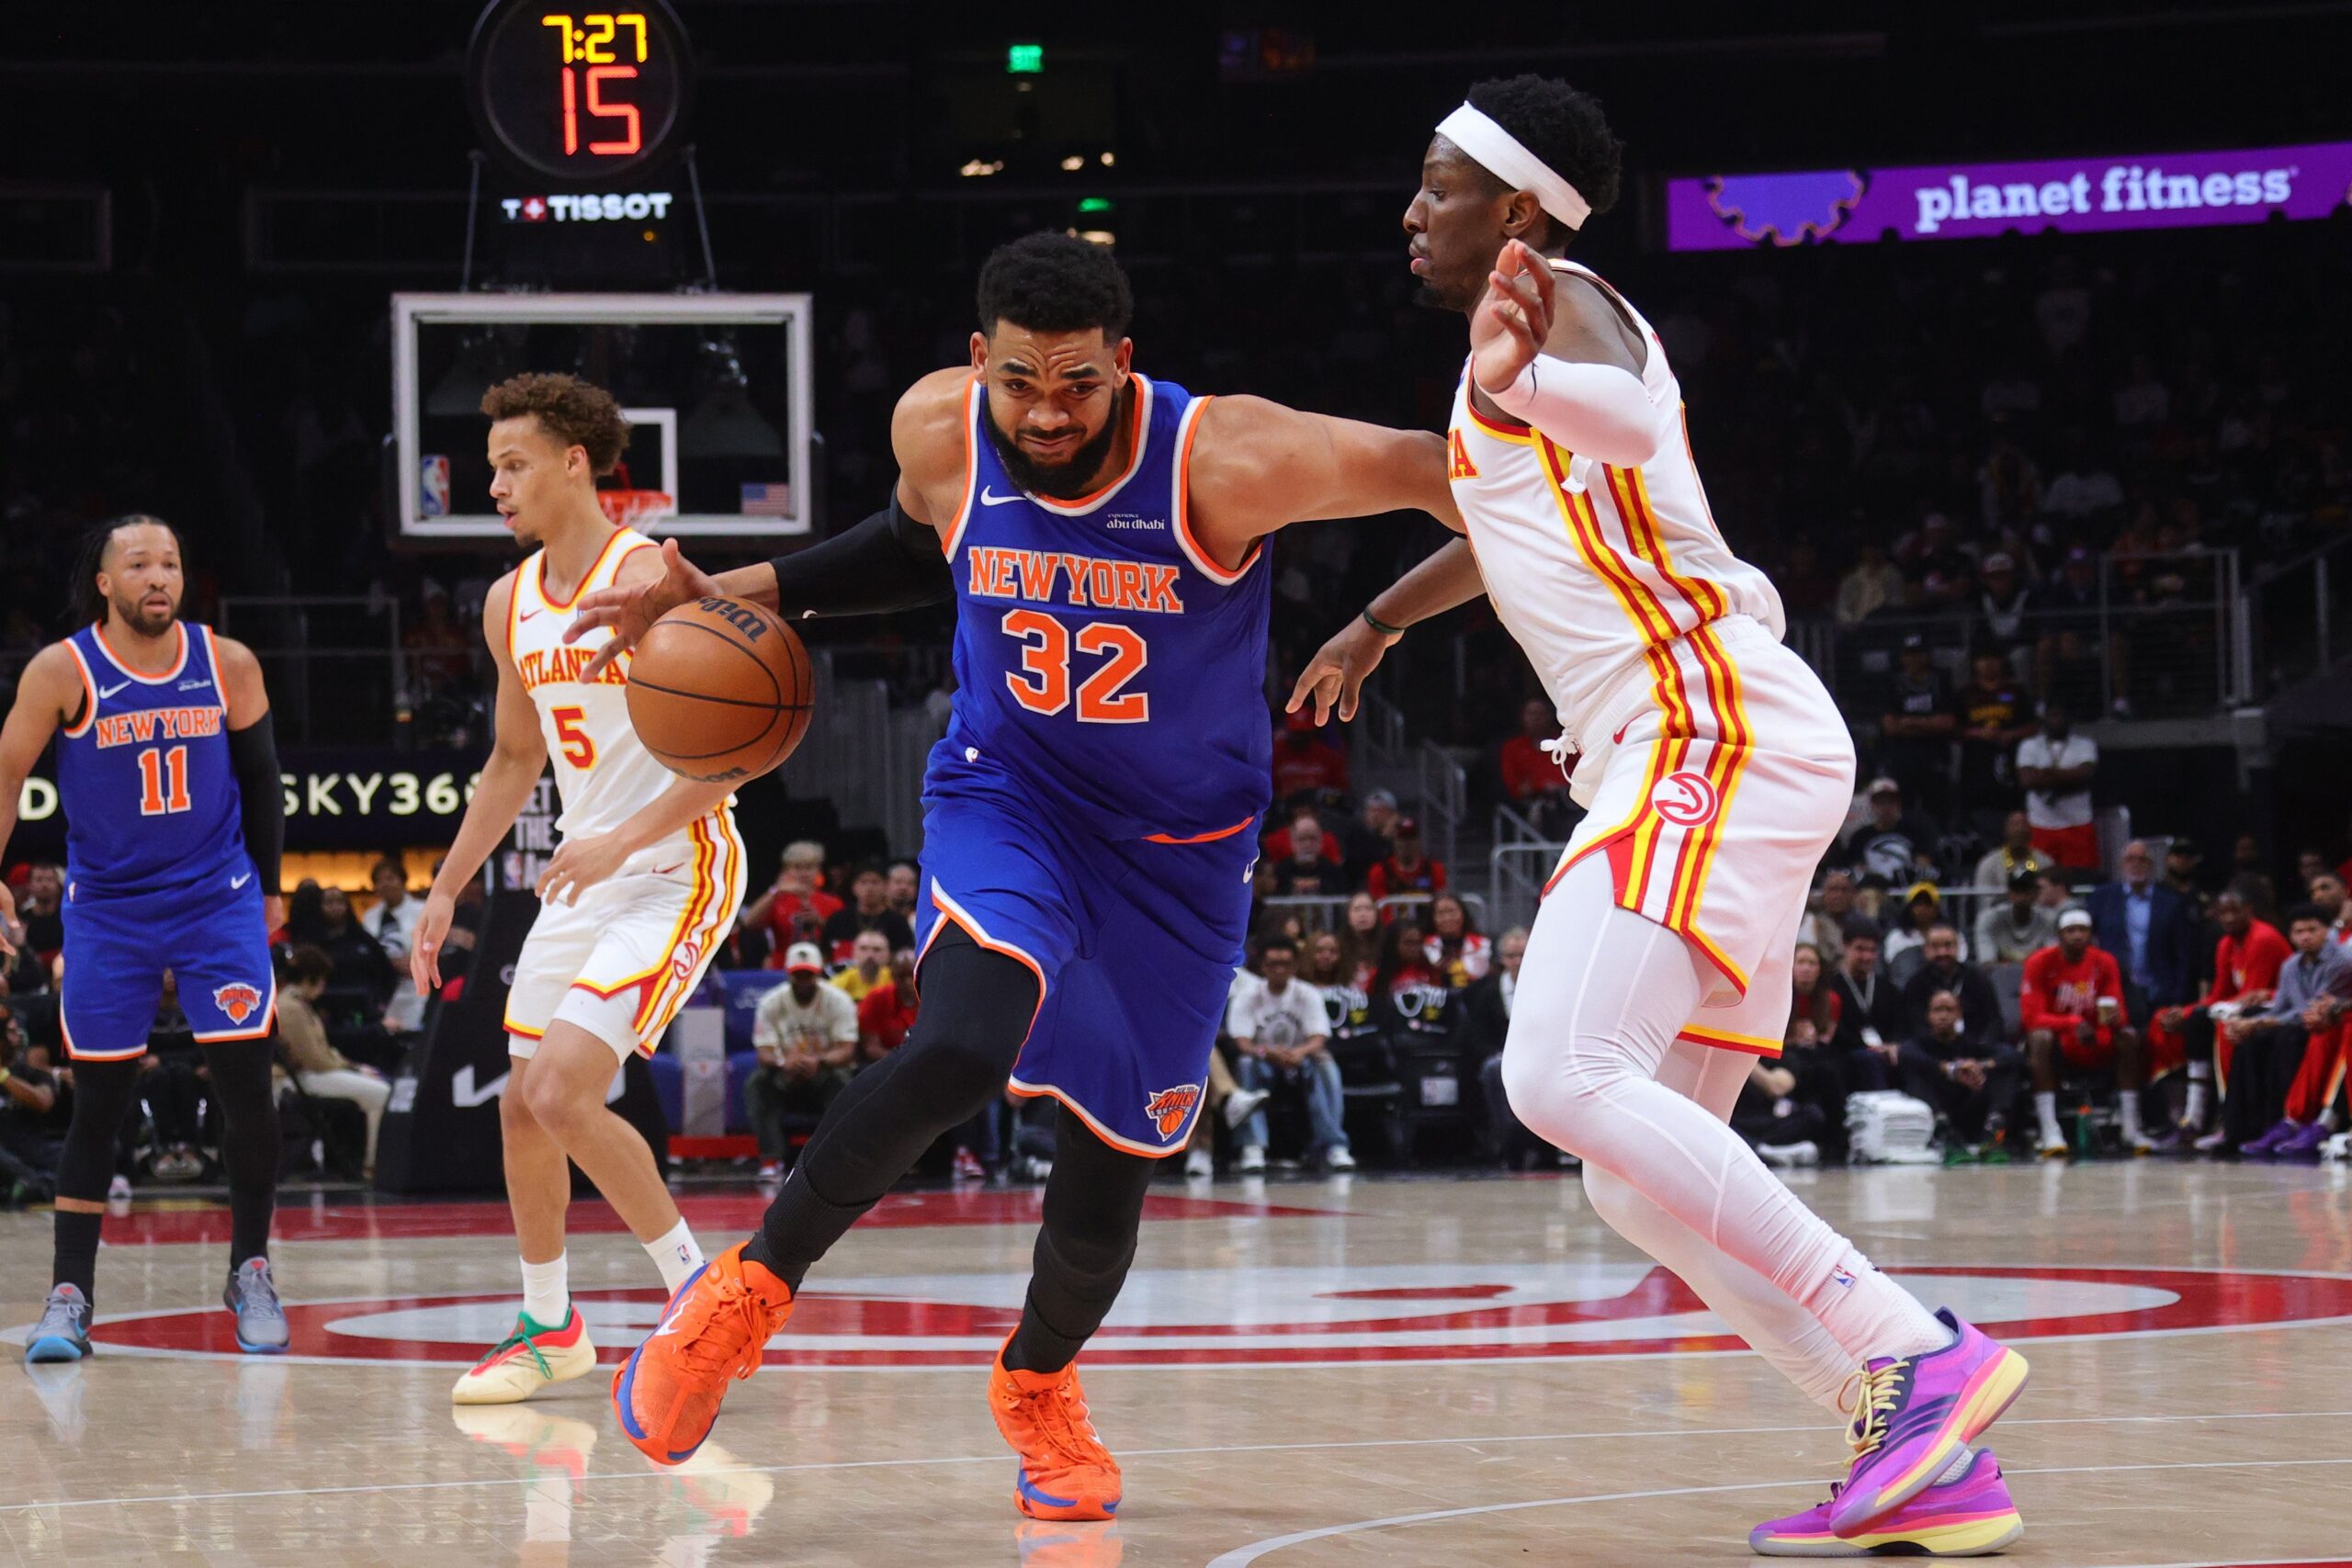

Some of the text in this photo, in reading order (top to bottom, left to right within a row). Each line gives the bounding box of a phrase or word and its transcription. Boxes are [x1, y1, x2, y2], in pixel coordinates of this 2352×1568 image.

[542, 14, 648, 64] 7:27
[561, 65, 642, 155] 15
[547, 192, 673, 222] TISSOT
[1915, 166, 2291, 233] planet fitness
[1106, 518, 1166, 530] abu dhabi
[967, 546, 1185, 615] NEW YORK
[1001, 608, 1150, 724] 32
[95, 705, 223, 750] NEW YORK
[551, 705, 599, 770] 5
[138, 744, 192, 816] 11
[514, 815, 555, 851] THE
